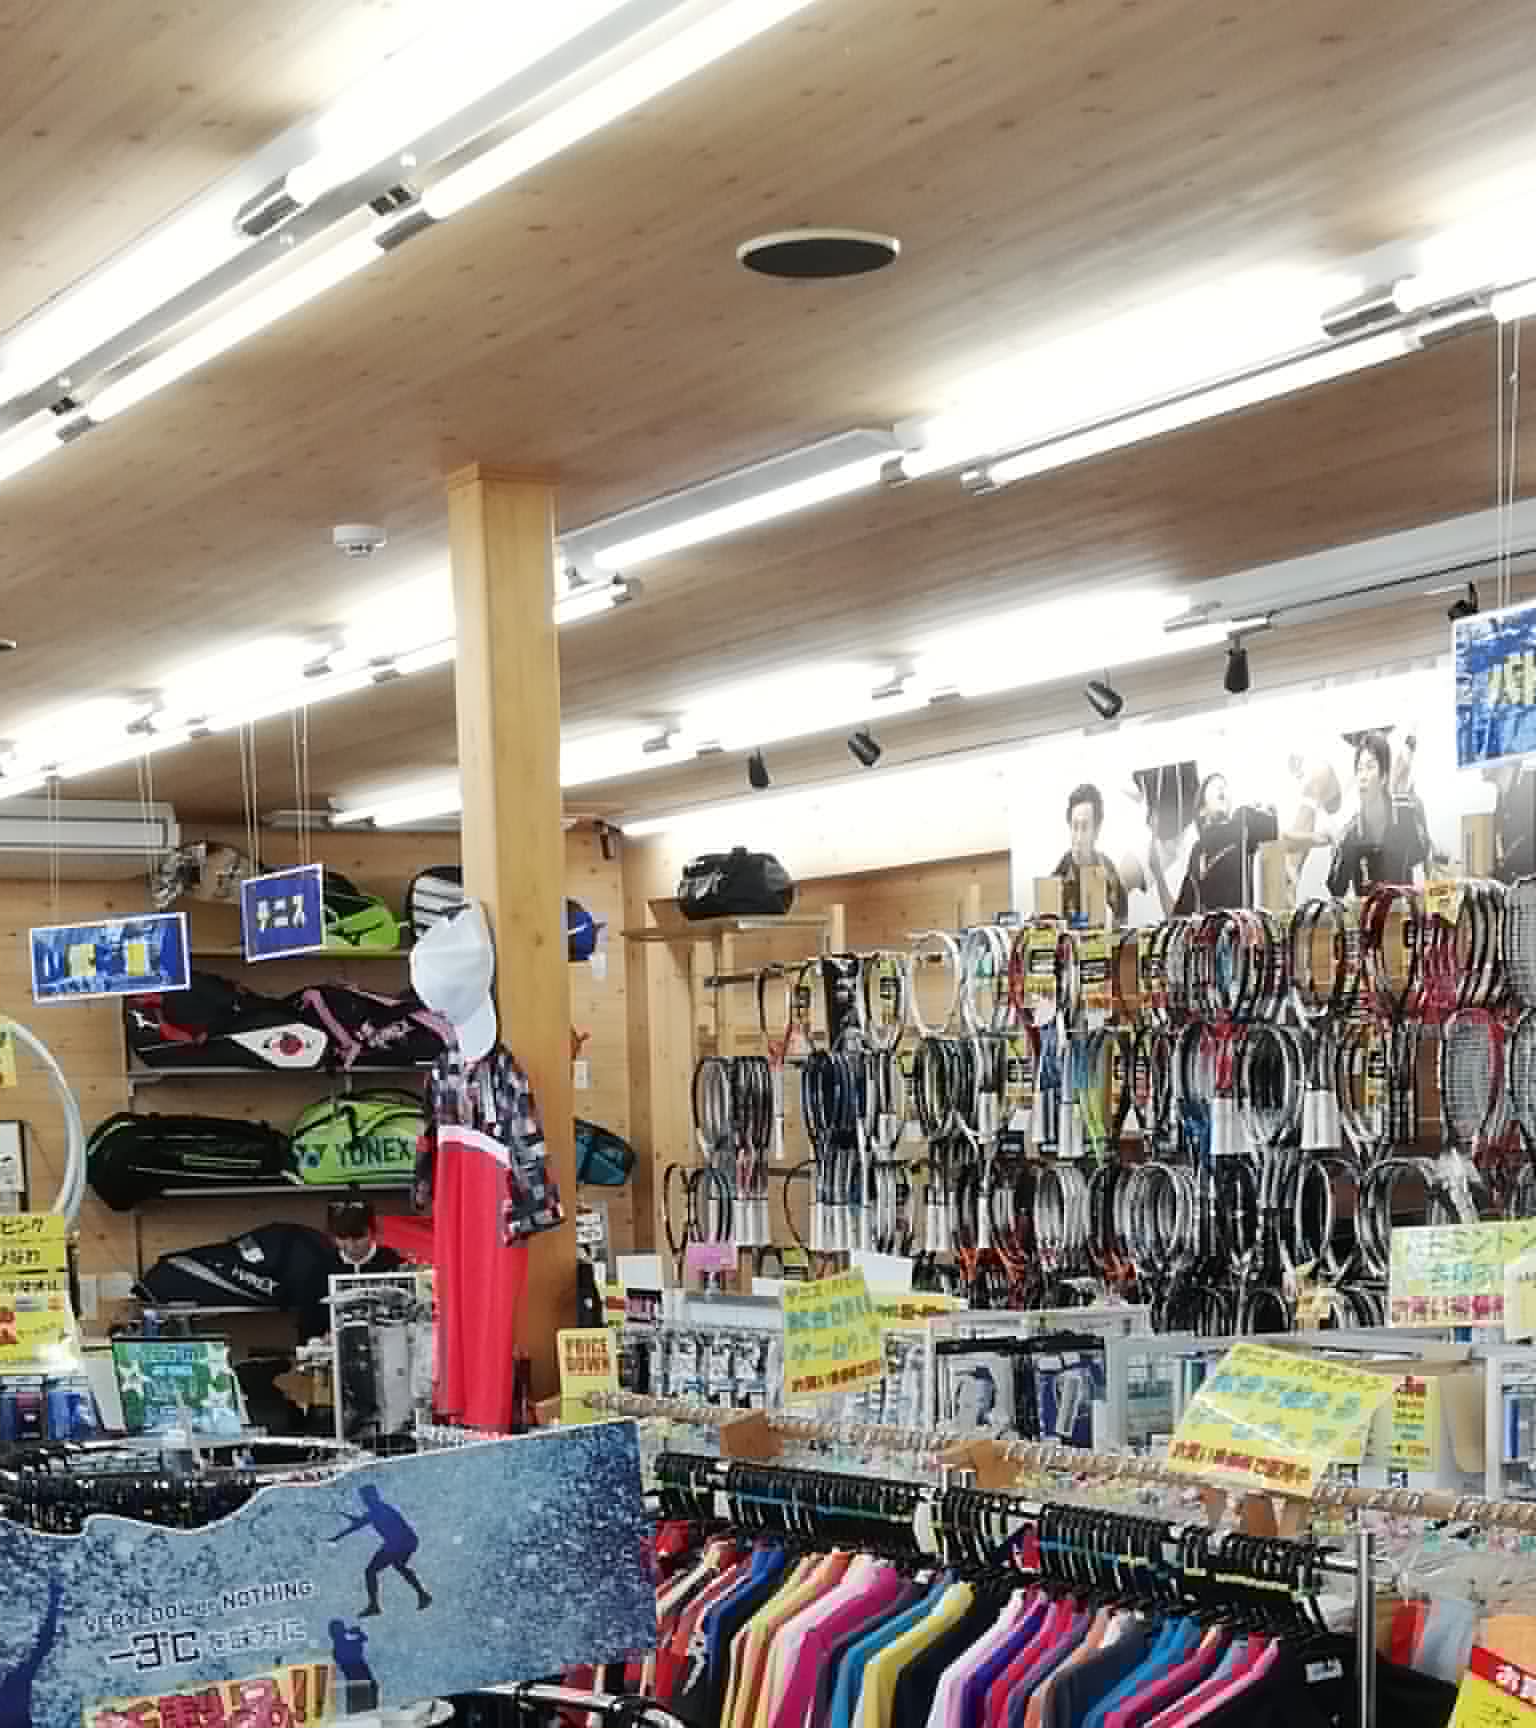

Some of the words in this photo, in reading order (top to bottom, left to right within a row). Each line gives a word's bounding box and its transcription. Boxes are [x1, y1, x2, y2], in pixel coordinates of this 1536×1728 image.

[255, 895, 306, 932] テニス
[336, 1136, 412, 1167] YONEX
[221, 1579, 314, 1609] NOTHING
